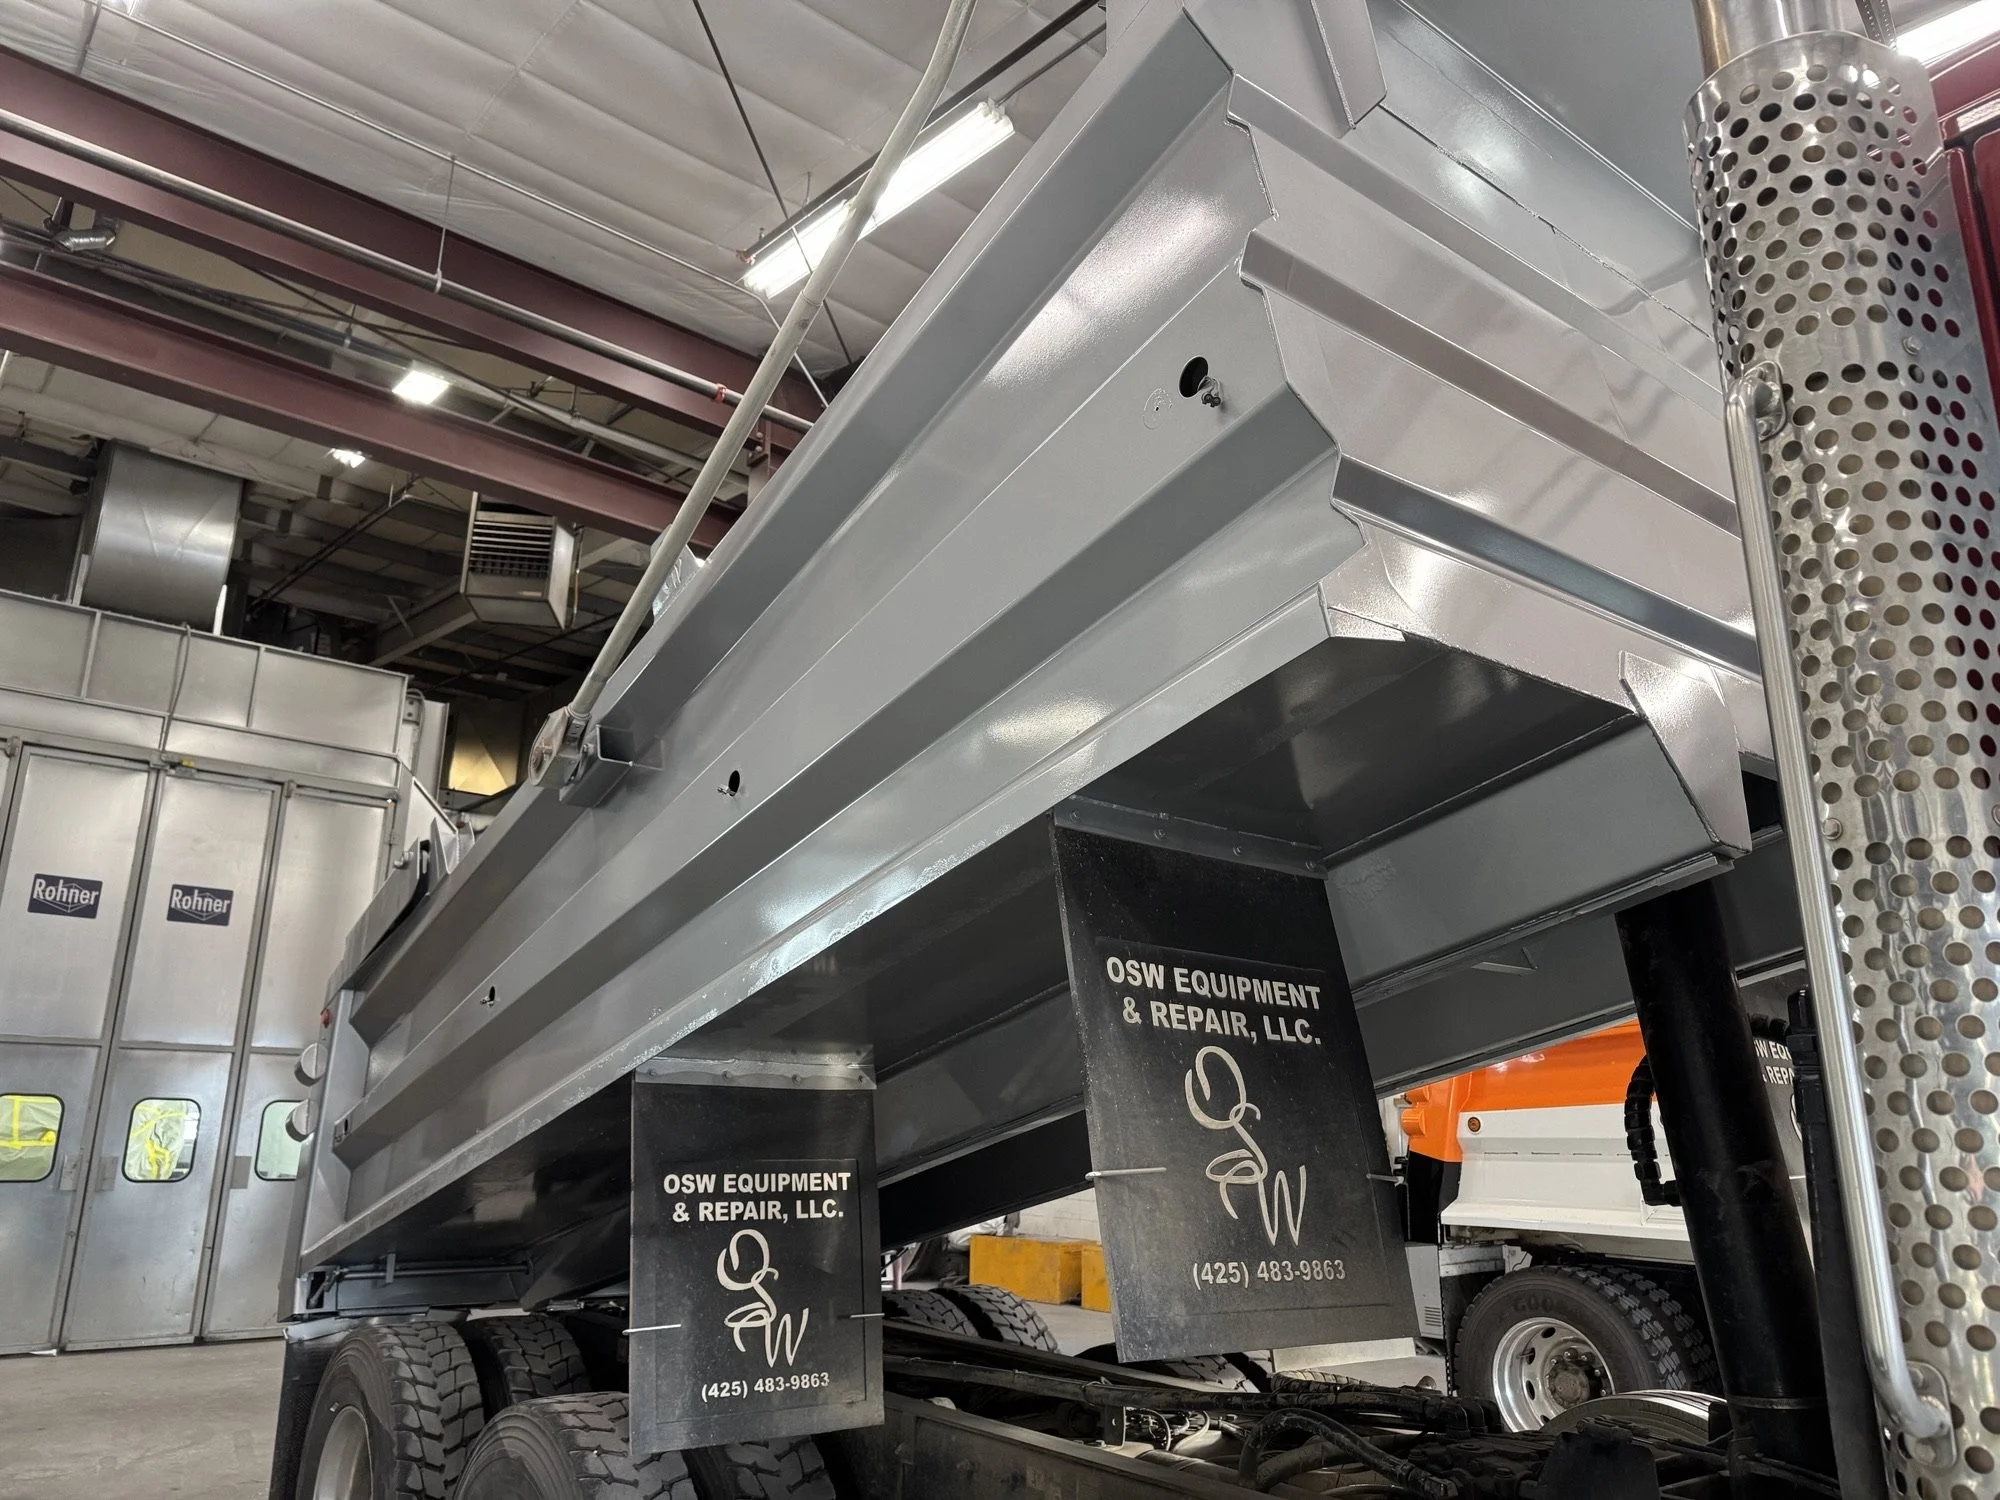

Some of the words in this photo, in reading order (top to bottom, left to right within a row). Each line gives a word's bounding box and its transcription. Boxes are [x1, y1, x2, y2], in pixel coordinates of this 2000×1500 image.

[32, 878, 99, 905] Rohner
[170, 888, 231, 913] Rohner
[1106, 956, 1165, 990] OSW
[1173, 967, 1321, 1010] EQUIPMENT
[1122, 996, 1142, 1025] &
[1149, 1000, 1258, 1045] REPAIR,
[1262, 1015, 1322, 1045] LLC.
[663, 1173, 717, 1194] OSW
[723, 1172, 851, 1194] EQUIPMENT
[672, 1202, 690, 1223] &
[698, 1200, 789, 1224] REPAIR,
[796, 1199, 844, 1219] LLC.
[1192, 1261, 1250, 1291] (425)
[1256, 1259, 1346, 1283] 483-9863
[701, 1380, 748, 1402] (425)
[753, 1371, 830, 1394] 483-9863
